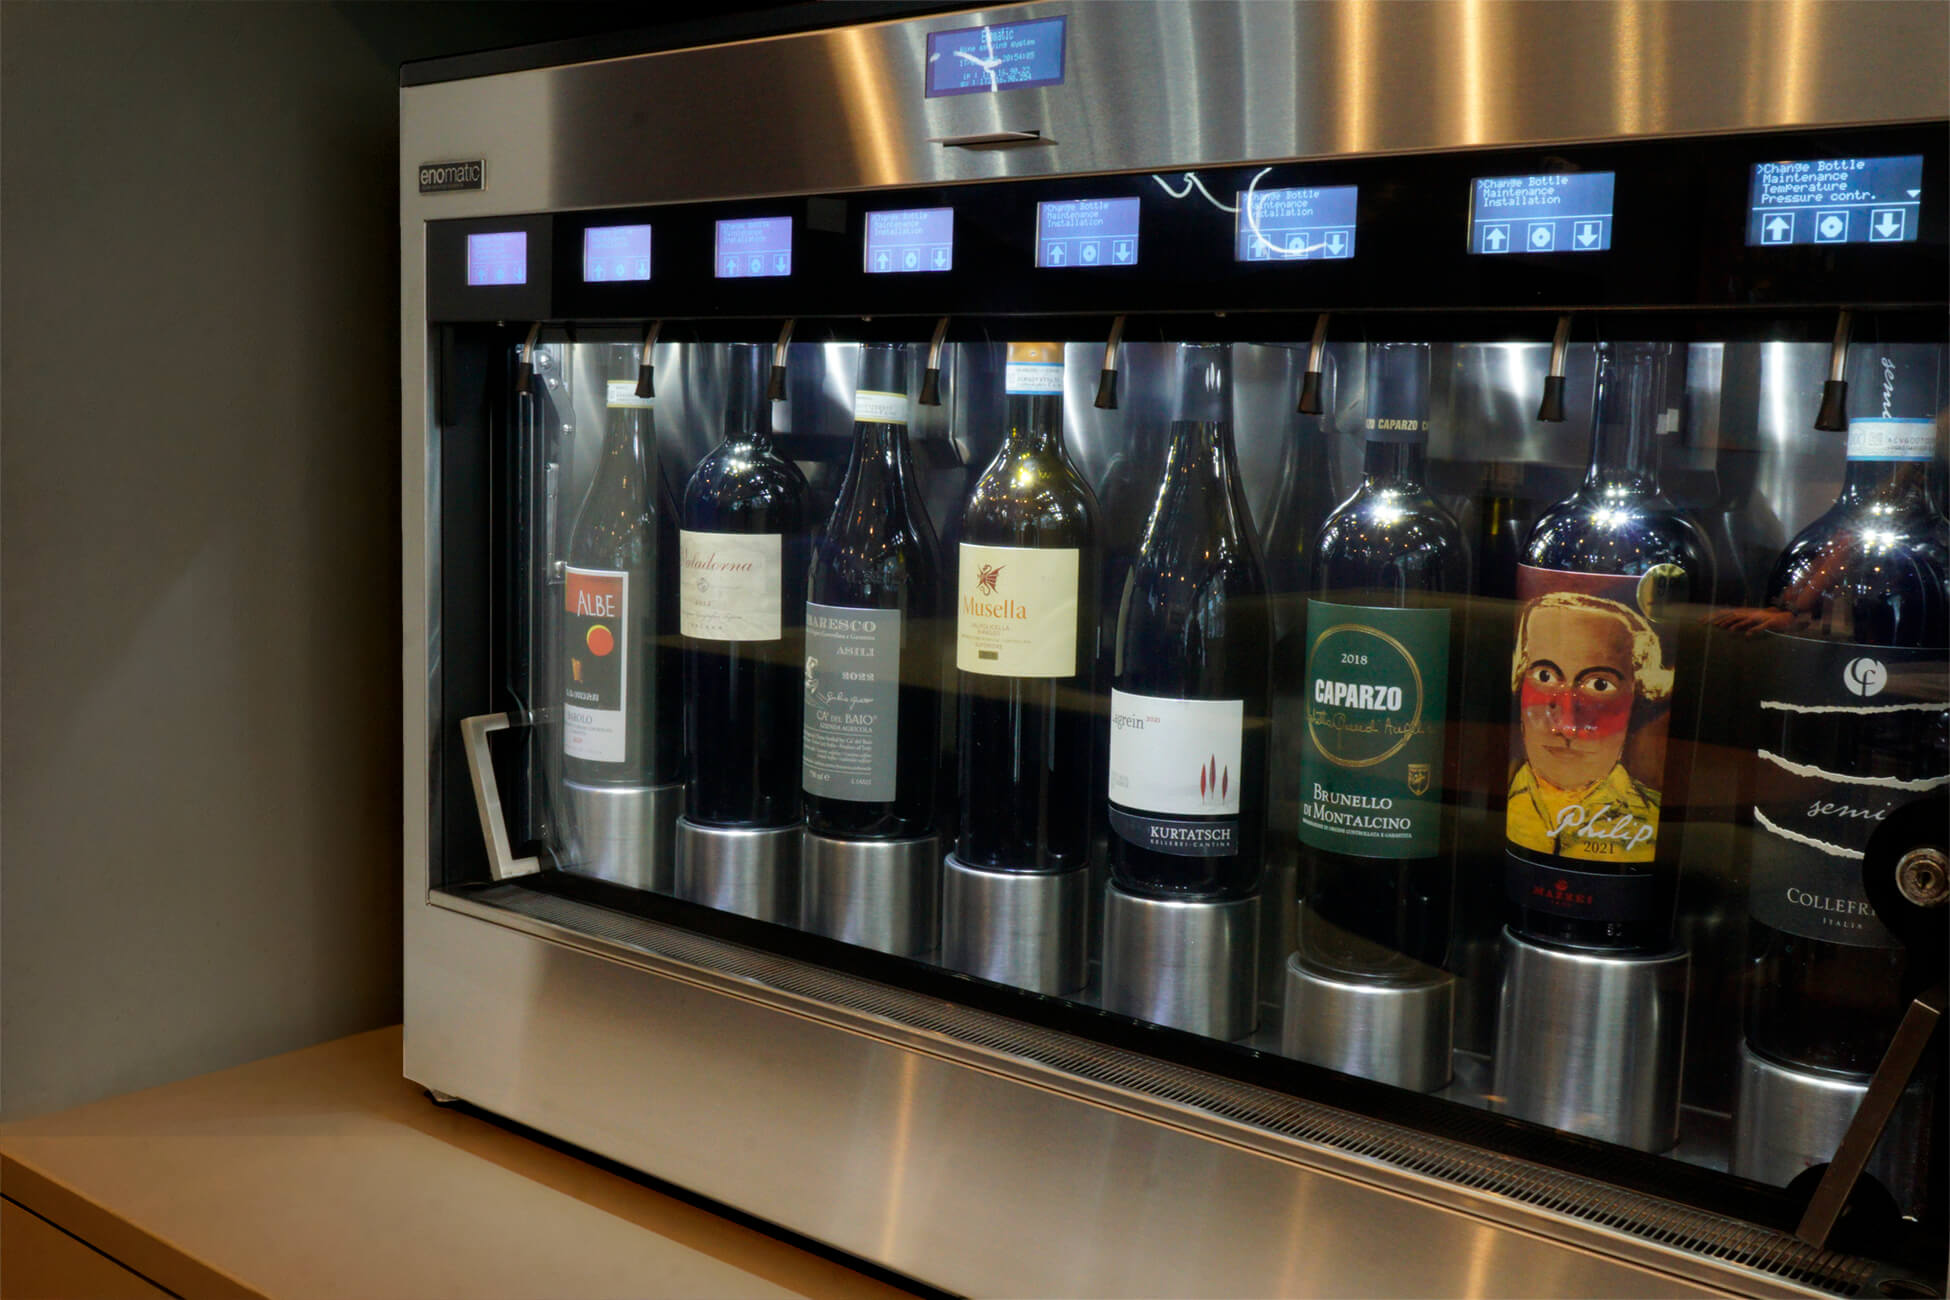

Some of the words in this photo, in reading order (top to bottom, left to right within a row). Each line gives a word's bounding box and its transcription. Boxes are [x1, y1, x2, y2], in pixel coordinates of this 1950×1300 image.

[1817, 159, 1865, 171] Bottle
[420, 163, 481, 185] enomatic
[1763, 172, 1848, 184] Maintenance
[1528, 175, 1568, 187] Bottle
[1286, 189, 1320, 200] Bottle
[1483, 186, 1555, 198] Maintenance
[1762, 182, 1848, 194] Temperature
[1483, 195, 1561, 208] Installation
[1761, 193, 1823, 204] Pressure
[1830, 189, 1876, 201] contr.
[1250, 200, 1309, 210] aintenance
[1378, 418, 1418, 430] CAPARZO
[577, 589, 615, 617] ALBE
[962, 592, 1027, 620] Musella
[1340, 653, 1368, 666] 2018
[1315, 678, 1403, 712] CAPARZO
[1807, 800, 1892, 822] semi
[1150, 825, 1231, 841] KURTATSCH
[1546, 804, 1653, 851] Philip
[1584, 840, 1615, 854] 2021
